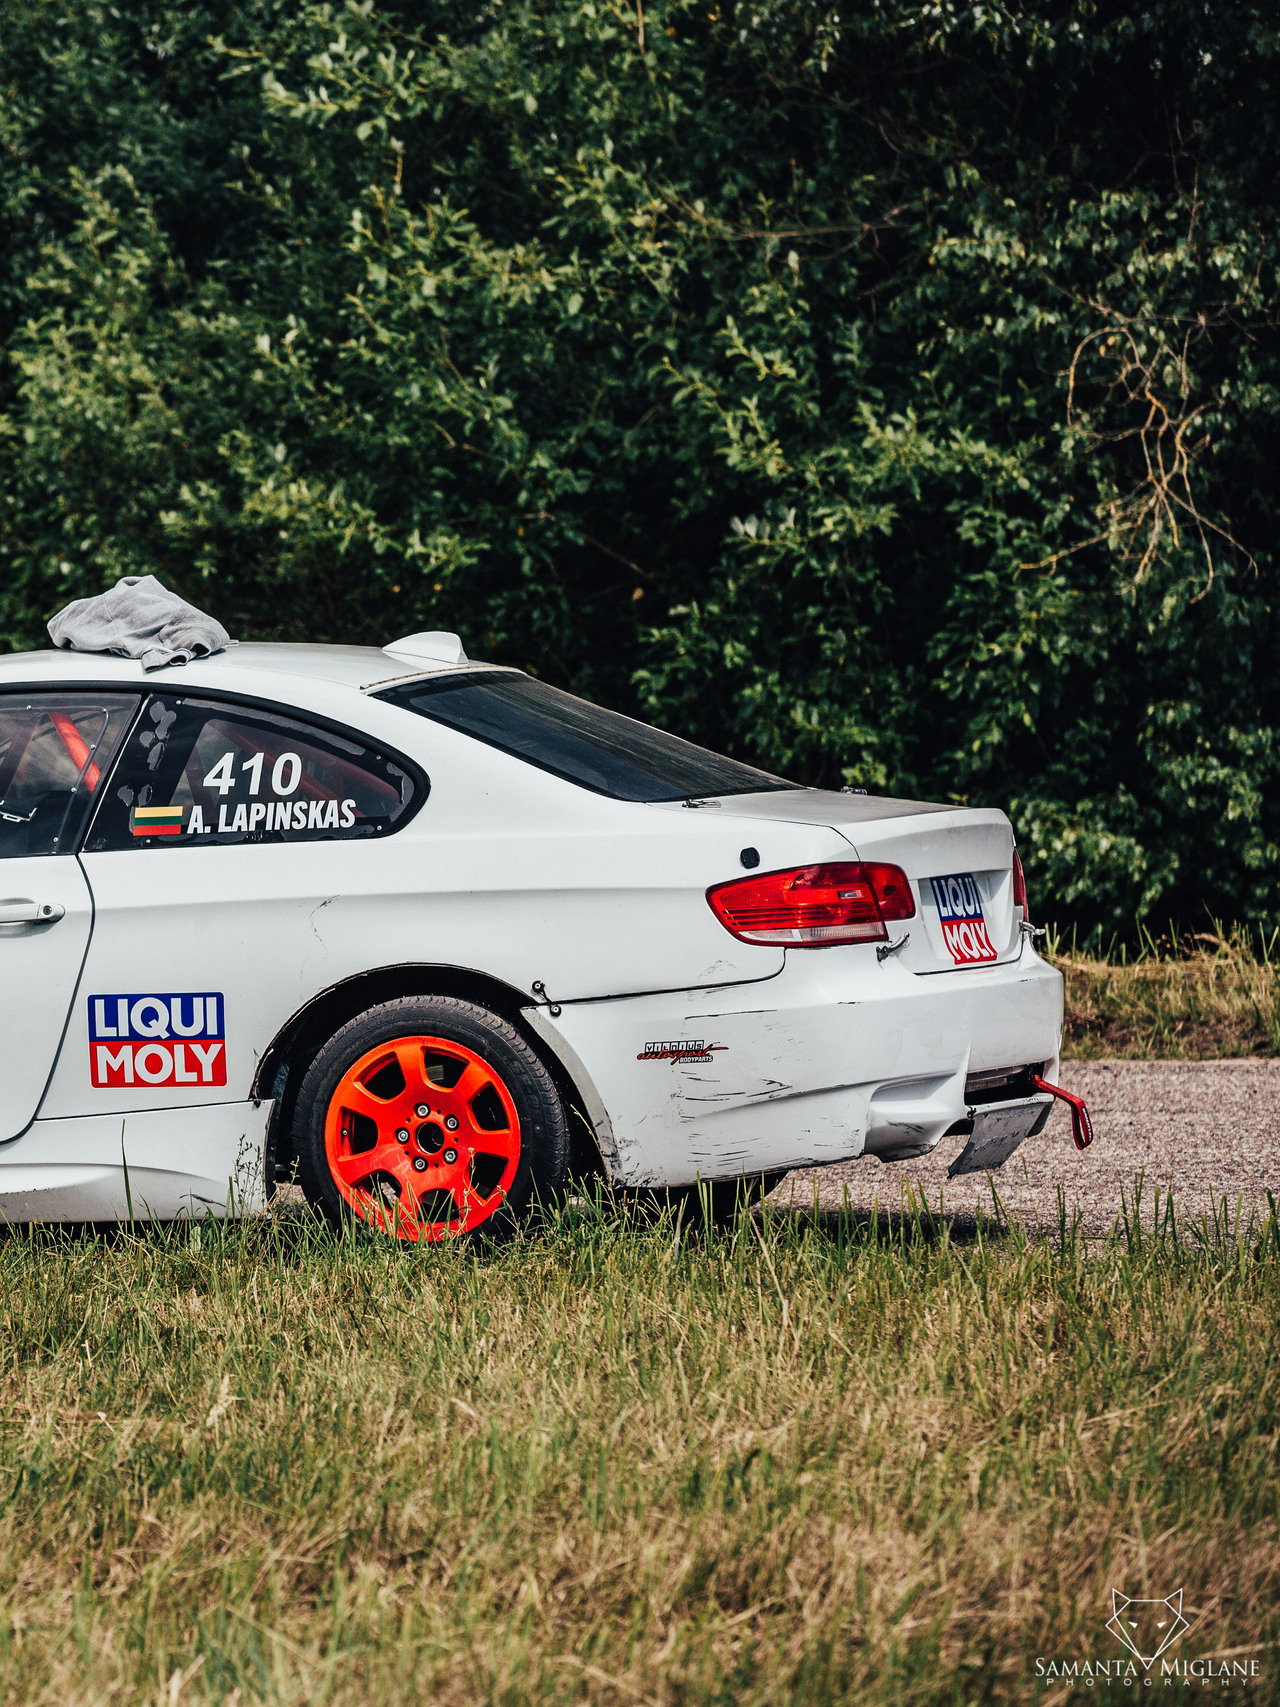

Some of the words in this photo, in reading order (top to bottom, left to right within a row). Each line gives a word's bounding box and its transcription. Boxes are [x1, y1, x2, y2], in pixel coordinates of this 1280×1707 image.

[202, 752, 303, 796] 410
[187, 805, 211, 834] A.
[217, 799, 357, 833] LAPINSKAS
[932, 877, 981, 918] LIQUI
[943, 922, 995, 961] MOLY
[94, 997, 218, 1040] LIQUI
[96, 1044, 223, 1084] MOLY
[679, 1056, 714, 1064] BODYPARTS
